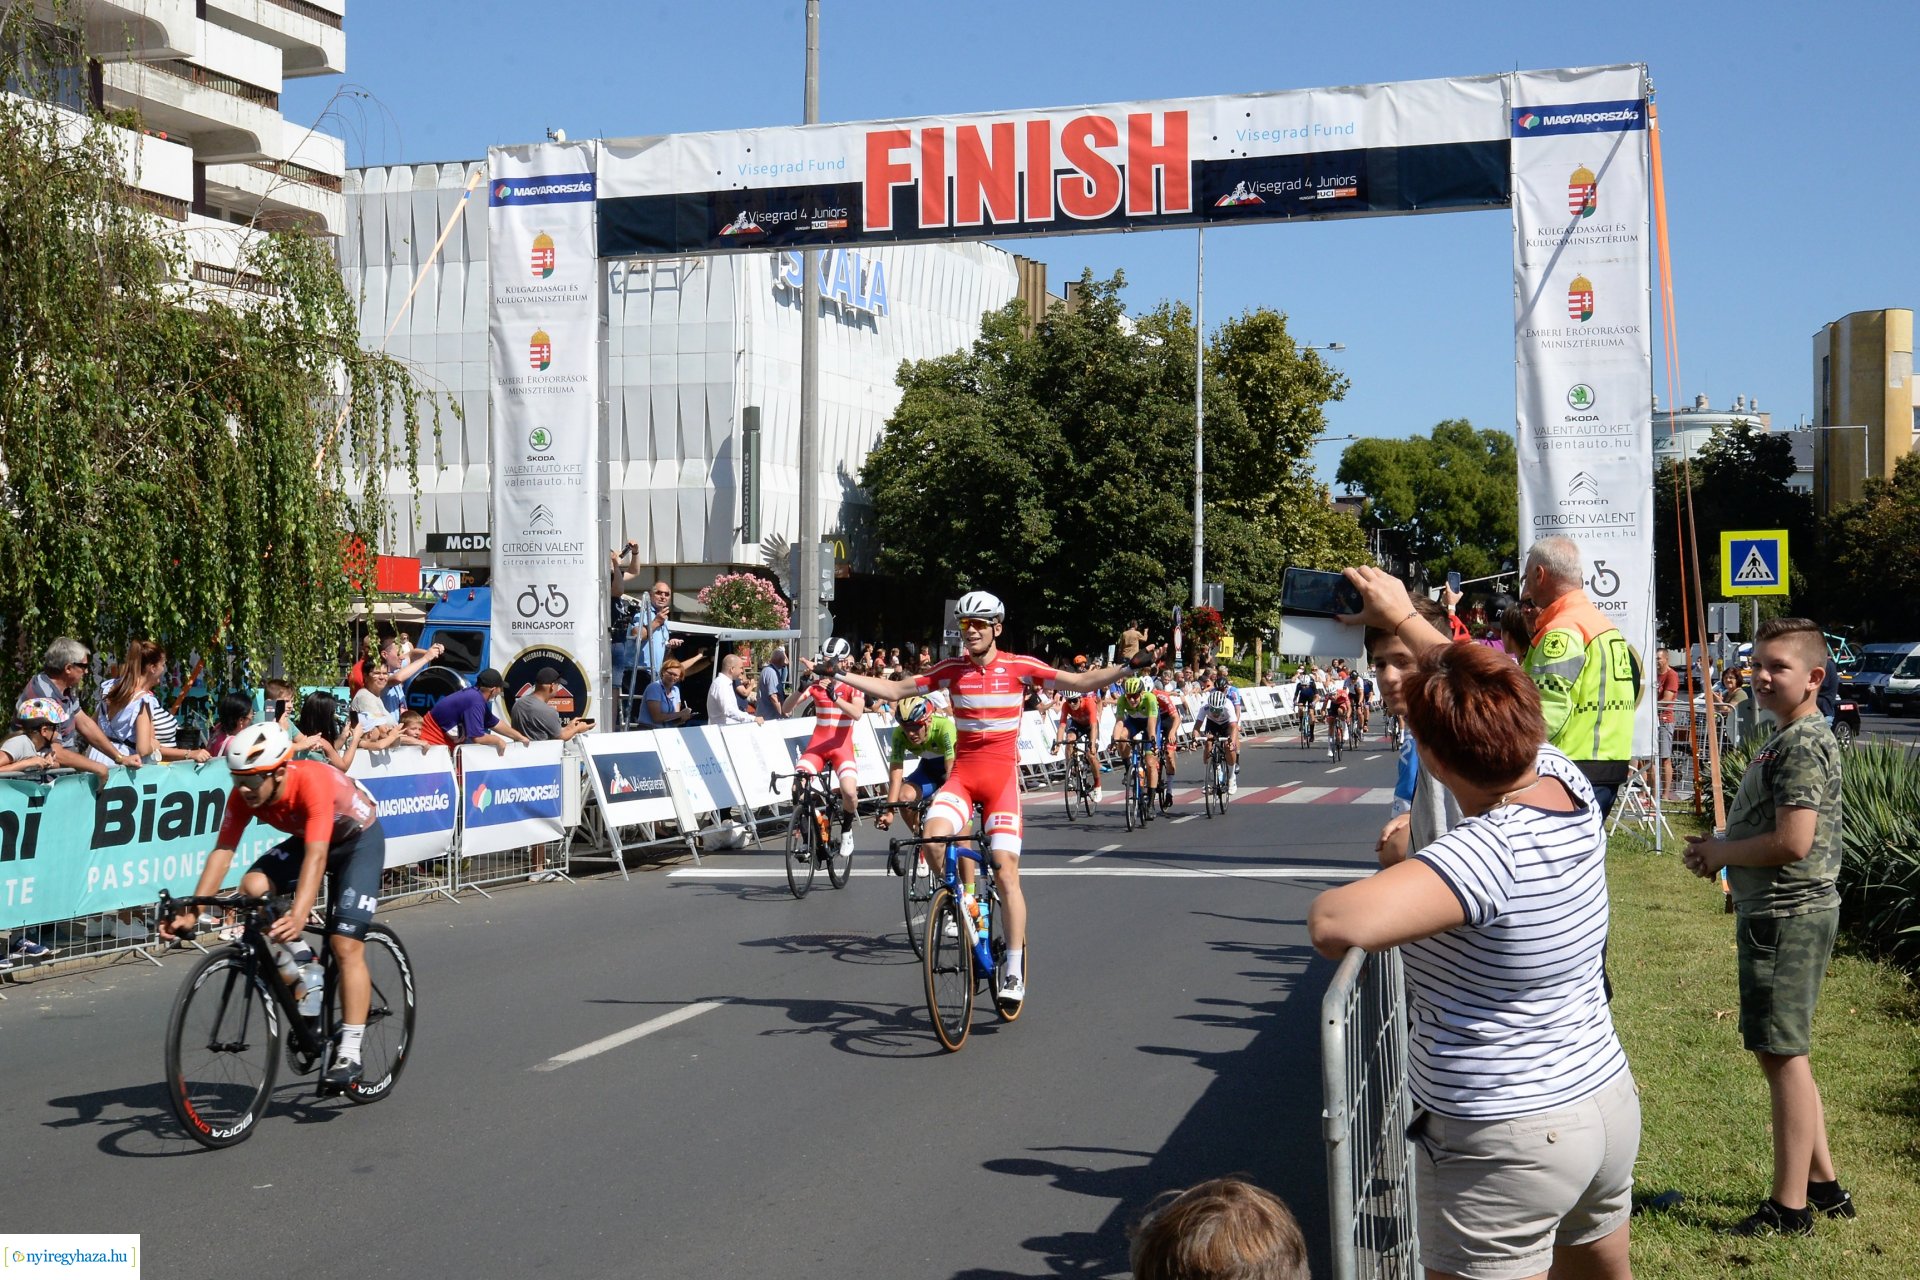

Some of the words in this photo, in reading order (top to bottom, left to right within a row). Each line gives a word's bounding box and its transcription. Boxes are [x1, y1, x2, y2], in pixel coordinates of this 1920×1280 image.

[1543, 108, 1639, 126] MAGYARORSZÁG
[1236, 125, 1309, 143] Visegrad
[1314, 122, 1355, 137] Fund
[737, 160, 804, 178] Visegrad
[808, 156, 845, 171] Fund
[864, 110, 1191, 231] FINISH
[513, 181, 592, 197] MAGYARORSZÁG
[1247, 178, 1301, 195] Visegrad
[1304, 176, 1313, 189] 4
[1316, 174, 1357, 188] Juniors
[748, 208, 798, 225] Visegrad
[800, 208, 808, 220] 4
[811, 206, 848, 219] Juniors
[1537, 224, 1612, 236] KÜLGAZDASÁGI
[1616, 223, 1626, 232] ÉS
[1526, 235, 1639, 247] KÜLÜGYMINISZTÉRIUM
[570, 284, 578, 292] ÉS
[1526, 329, 1562, 338] EMBERI
[1540, 338, 1625, 349] MINISZTÉRIUMA
[498, 376, 524, 386] EMBERI
[508, 386, 575, 396] MINISZTÉRIUMA
[1534, 426, 1575, 435] VALENT
[1576, 424, 1607, 435] AUTÓ
[1535, 438, 1631, 450] valentauto.hu
[504, 465, 534, 474] VALENT
[504, 475, 582, 487] valentauto.hu
[1533, 512, 1585, 526] CITROËN
[1588, 512, 1636, 524] VALENT
[502, 542, 543, 553] CITROËN
[545, 542, 584, 552] VALENT
[503, 557, 584, 566] citroenvalent.hu
[511, 621, 575, 630] BRINGASPORT
[494, 780, 560, 805] MAGYARORSZÁG
[375, 789, 450, 818] MAGYARORSZÁG
[91, 784, 226, 850] Bian
[87, 856, 205, 893] PASSIONE
